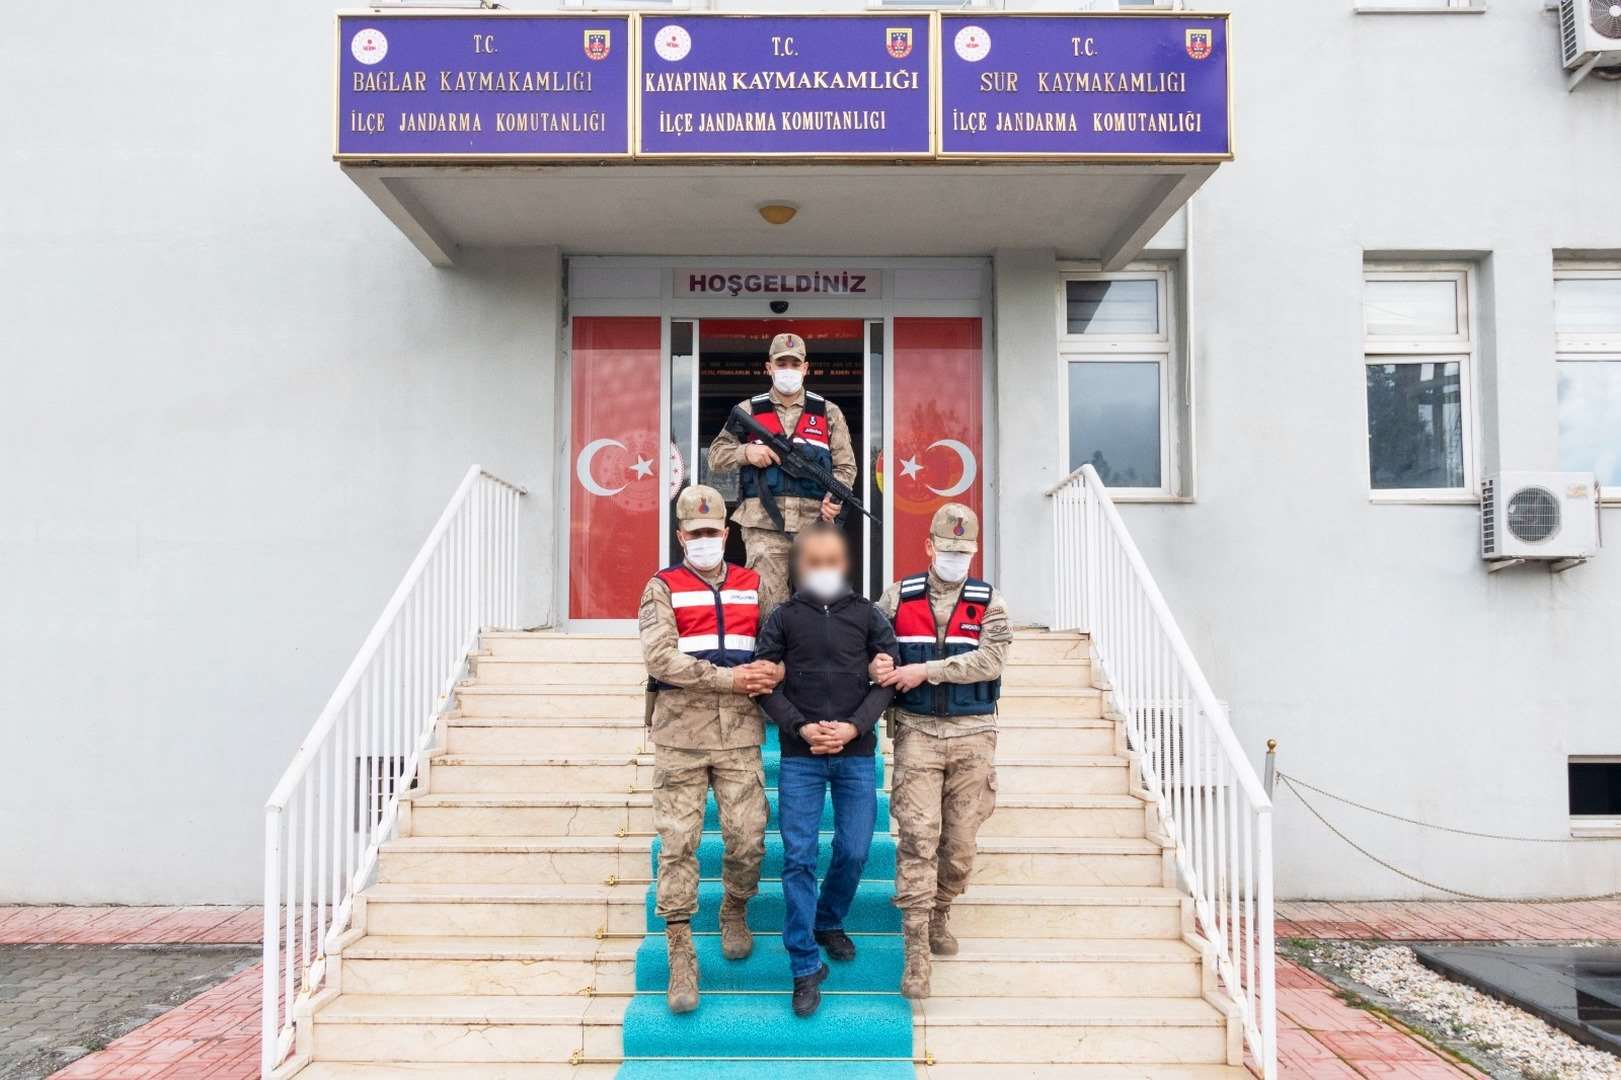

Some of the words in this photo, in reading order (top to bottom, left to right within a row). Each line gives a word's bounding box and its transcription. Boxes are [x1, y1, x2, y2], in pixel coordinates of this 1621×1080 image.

[473, 34, 498, 53] T.C.
[772, 36, 799, 56] T.C.
[1072, 37, 1098, 56] T.C.
[645, 72, 727, 92] KAYAPINAR
[732, 69, 919, 90] KAYMAKAMLIĞI
[980, 72, 1018, 92] SUR
[351, 110, 385, 134] İLÇE
[400, 113, 482, 132] JANDARMA
[496, 111, 606, 132] KOMUTANLIĞI
[659, 111, 693, 136] İLÇE
[699, 113, 776, 133] JANDARMA
[953, 109, 987, 134] İLÇE
[996, 112, 1078, 132] JANDARMA
[1093, 110, 1202, 132] KOMUTANLIĞI
[689, 271, 867, 297] HOŞGELDİNİZ
